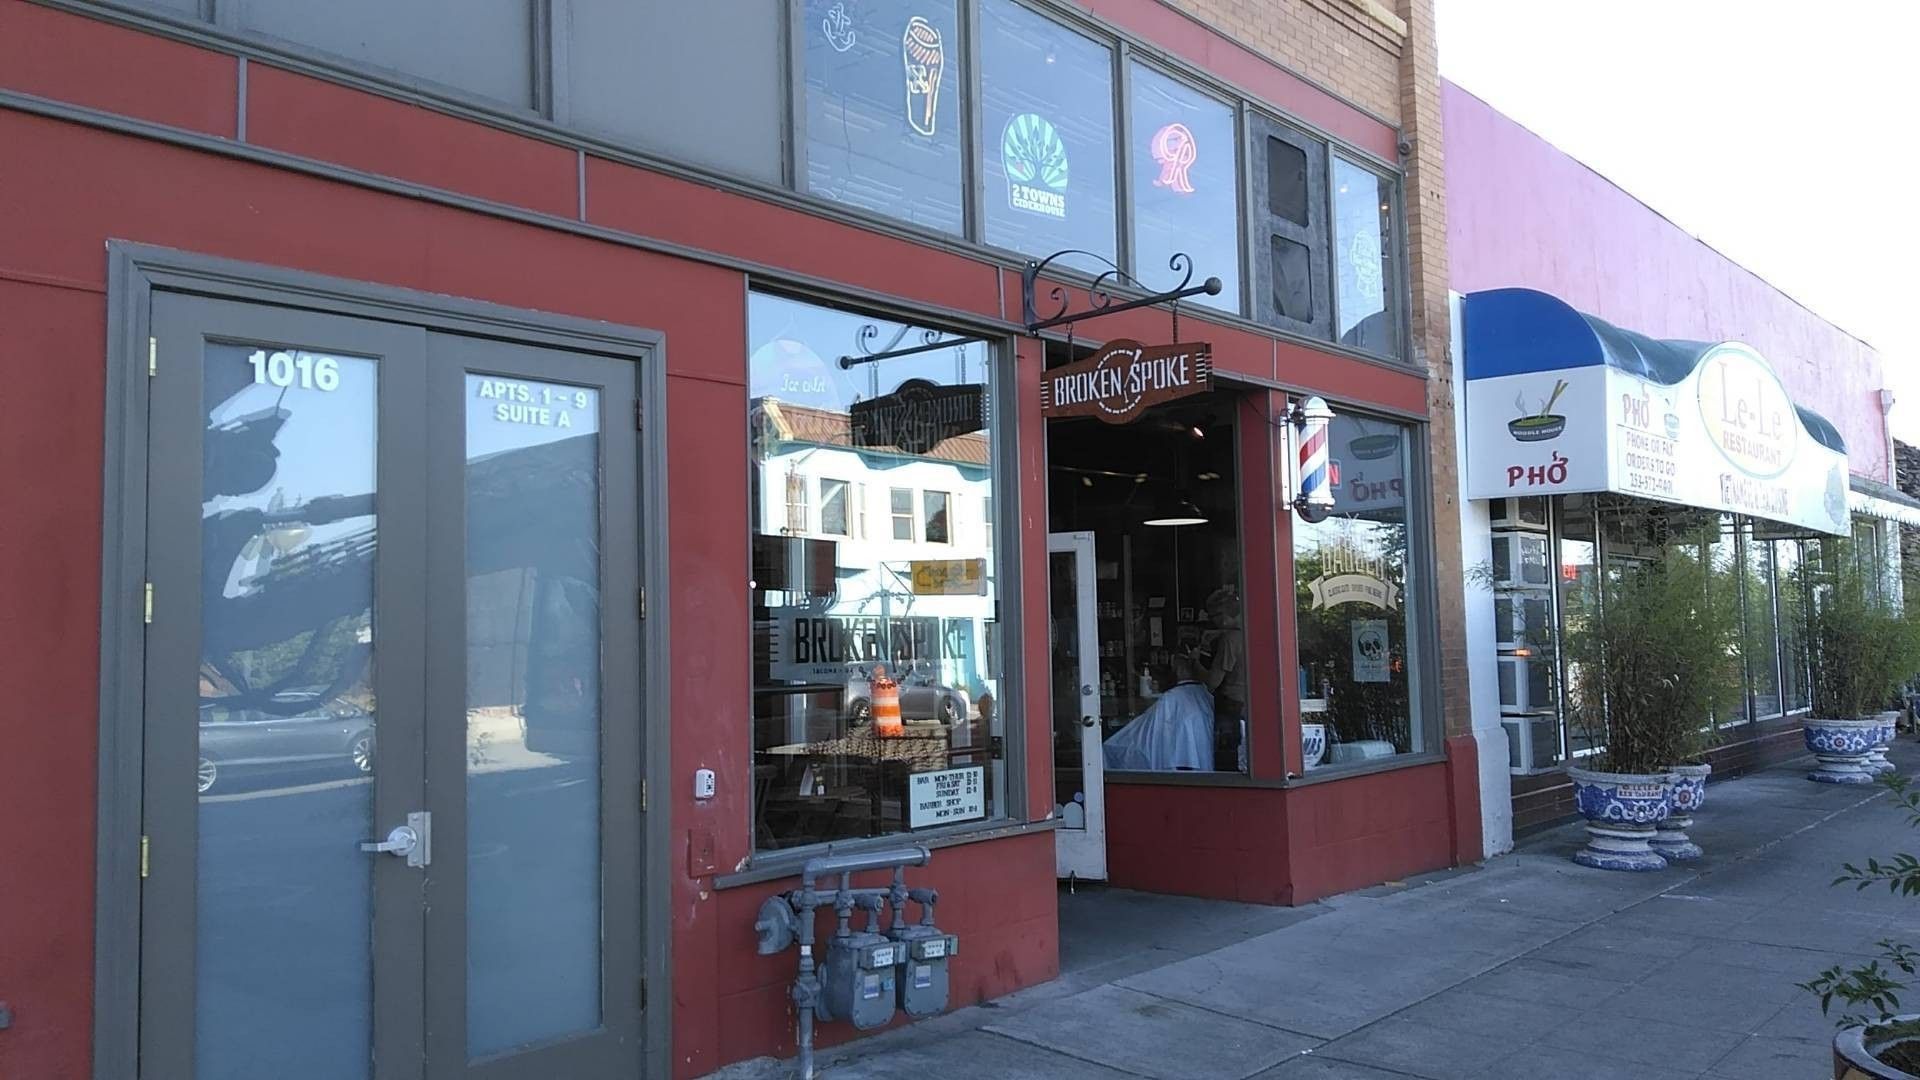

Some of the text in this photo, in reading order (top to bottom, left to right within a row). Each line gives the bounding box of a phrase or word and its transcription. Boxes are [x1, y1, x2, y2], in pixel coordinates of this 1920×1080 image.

[1012, 183, 1065, 209] 2 TOWNS
[1012, 198, 1066, 218] CIDERHOUSE
[248, 350, 339, 392] 1016
[1054, 354, 1190, 406] BROKEN SPOKE
[480, 379, 534, 403] APTS.
[574, 390, 587, 409] 9
[496, 403, 571, 428] SUITE A
[1722, 430, 1784, 467] RESTAURANT
[1666, 461, 1677, 477] GO
[795, 617, 889, 664] BROKEN
[936, 789, 959, 798] SUNDAY
[946, 798, 961, 806] SHOP
